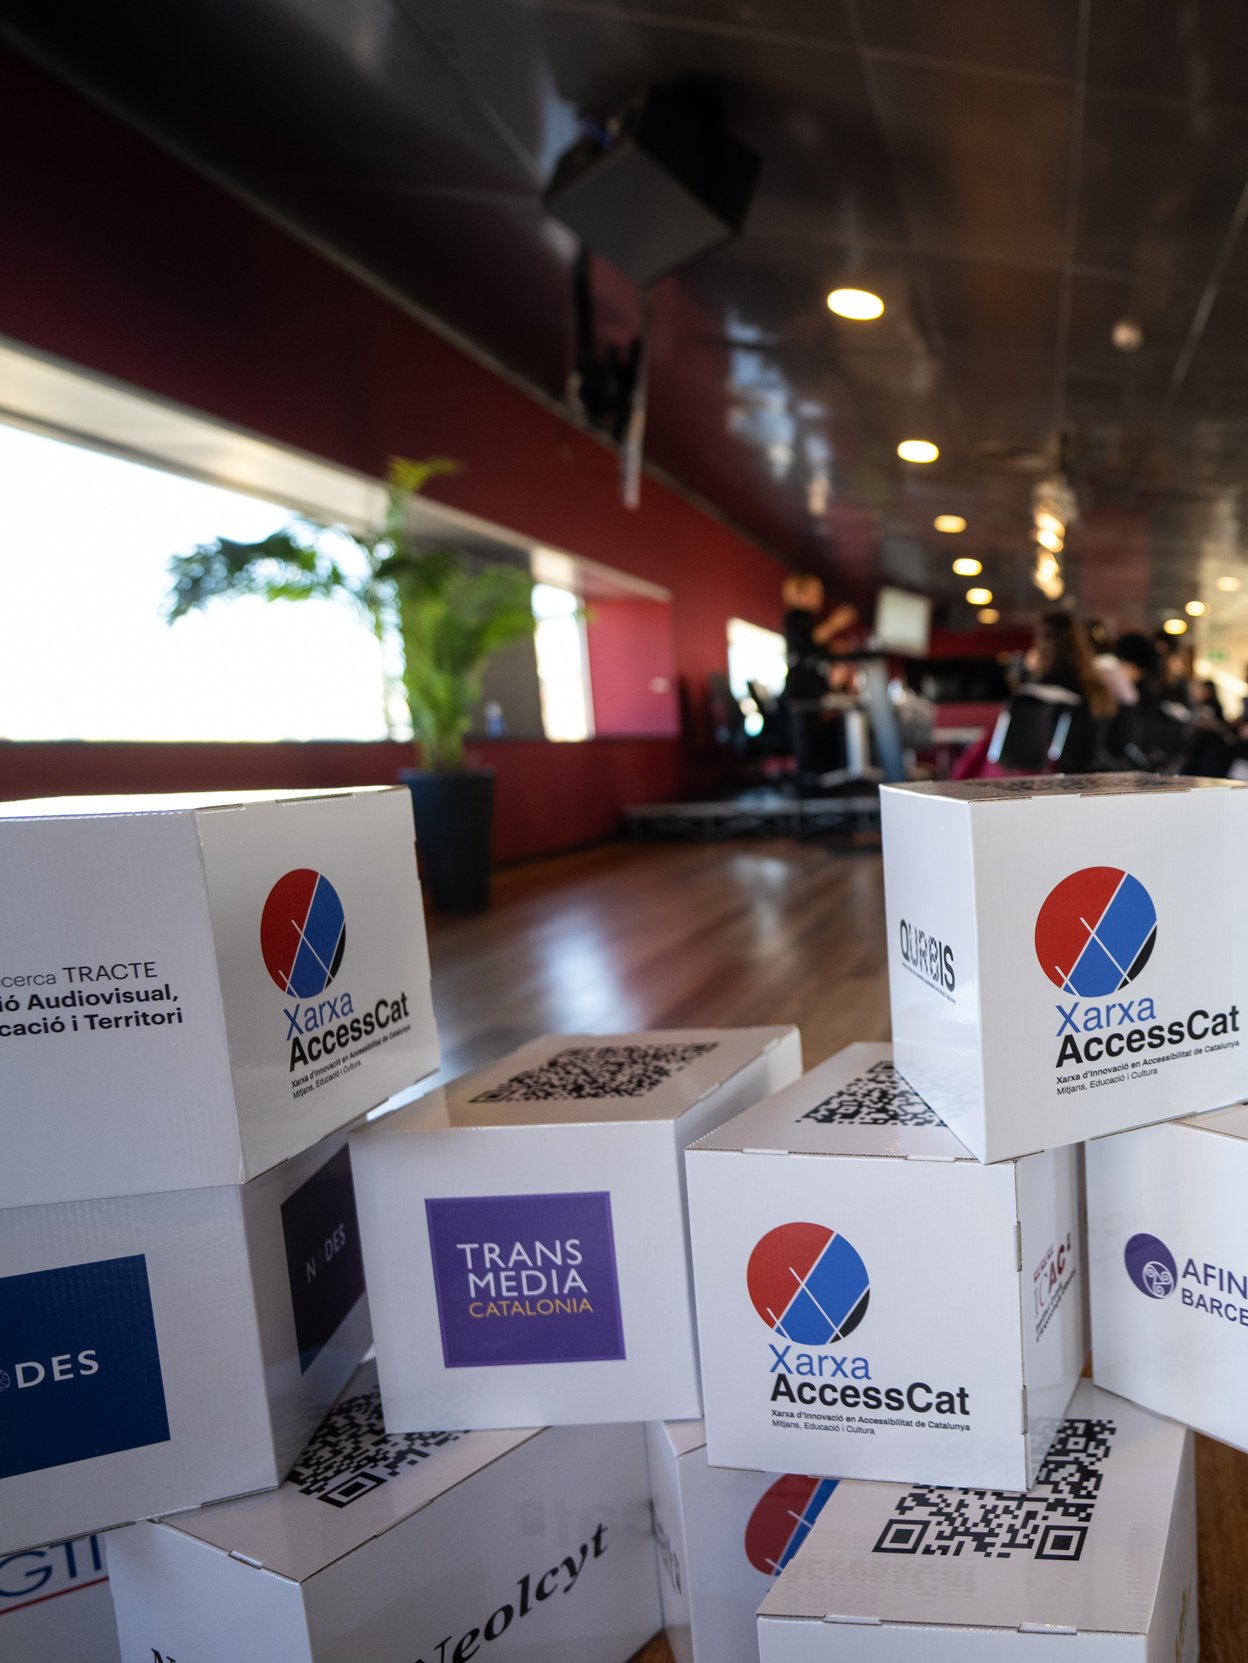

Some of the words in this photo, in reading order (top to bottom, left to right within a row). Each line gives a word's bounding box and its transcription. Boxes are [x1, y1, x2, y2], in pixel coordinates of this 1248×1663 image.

[0, 973, 56, 988] cerca
[62, 961, 158, 983] TRACTE
[27, 983, 178, 1011] Audiovisual,
[71, 1015, 78, 1031] i
[84, 1007, 183, 1030] Territori
[283, 992, 354, 1041] Xarxa
[1055, 997, 1156, 1037] Xarxa
[289, 991, 409, 1073] AccessCat
[1055, 1005, 1240, 1069] AccessCat
[1056, 1074, 1081, 1085] Xarxa
[1082, 1063, 1129, 1080] d'Innovació
[1131, 1061, 1141, 1069] en
[1142, 1049, 1192, 1067] Accessibilitat
[1193, 1047, 1203, 1056] de
[1204, 1040, 1240, 1054] Catalunya
[291, 1075, 309, 1090] Xarxa
[1056, 1083, 1088, 1096] Mitjans,
[1090, 1074, 1125, 1089] Educació
[1131, 1067, 1158, 1080] Cultura
[306, 1223, 346, 1283] NDES
[456, 1239, 583, 1269] TRANS
[468, 1268, 588, 1298] MEDIA
[1181, 1257, 1248, 1299] AFIN
[469, 1297, 594, 1318] CATALONIA
[768, 1344, 872, 1380] Xarxa
[770, 1373, 970, 1415] AccessCat
[771, 1409, 795, 1418] Xarxa
[797, 1411, 844, 1422] d'Innovació
[846, 1415, 856, 1423] en
[857, 1415, 913, 1427] Accessibilitat
[915, 1419, 926, 1428] de
[927, 1421, 970, 1431] Catalunya
[772, 1419, 802, 1430] Mitjans,
[804, 1422, 841, 1432] Educació
[846, 1425, 875, 1435] Cultura
